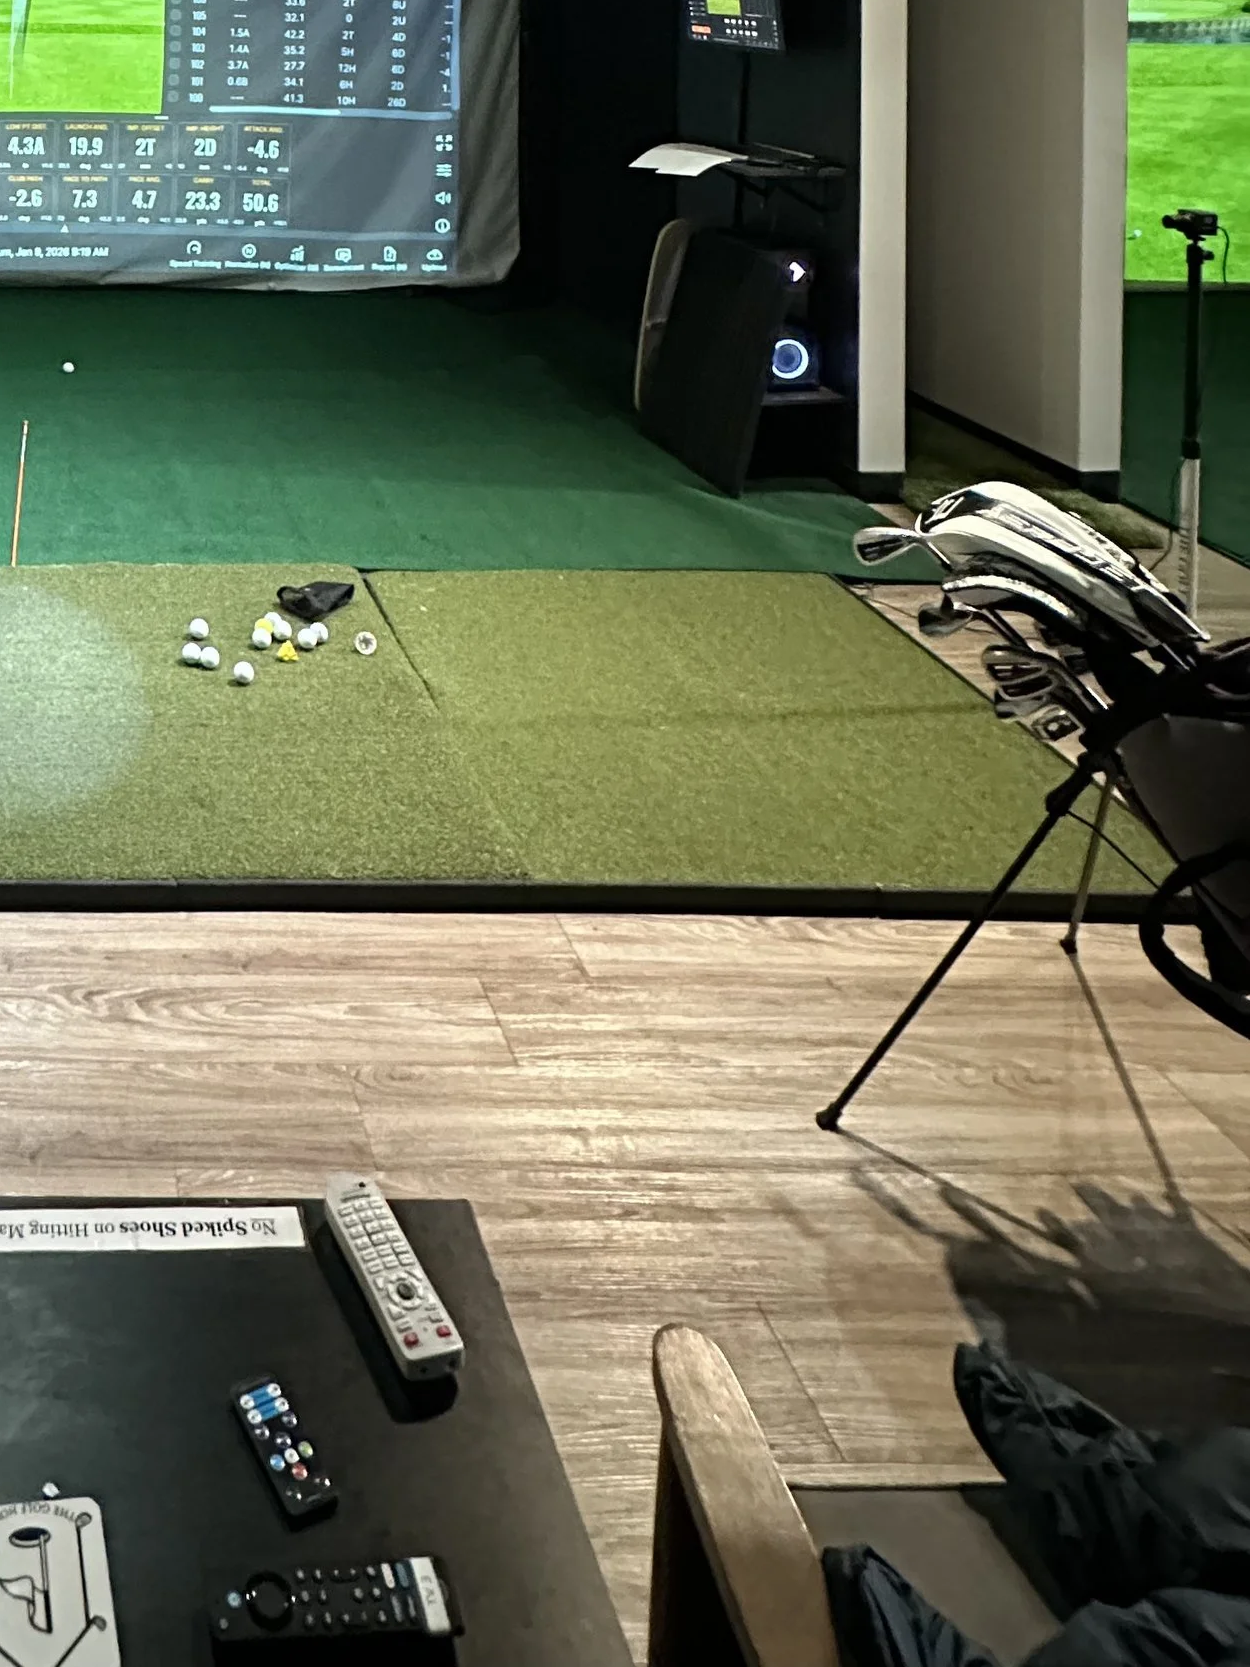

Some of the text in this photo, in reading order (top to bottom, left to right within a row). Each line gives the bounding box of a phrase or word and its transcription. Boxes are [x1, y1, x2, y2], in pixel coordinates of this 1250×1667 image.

[284, 13, 304, 22] 32.1
[230, 28, 250, 38] 1.5A
[284, 30, 305, 39] 42.2
[229, 44, 250, 54] 1.4A
[283, 45, 305, 55] 35.2
[227, 60, 249, 70] 3.7A
[283, 61, 305, 71] 27.7
[7, 136, 280, 159] 4.3A 19.9 2T 2D -4.6
[8, 189, 279, 213] -2.6 7.3 4.7 23.3 50.6
[29, 1220, 88, 1239] Hitting
[95, 1222, 115, 1234] on
[119, 1220, 177, 1236] Shoes
[182, 1218, 248, 1236] Spiked
[251, 1218, 277, 1236] No
